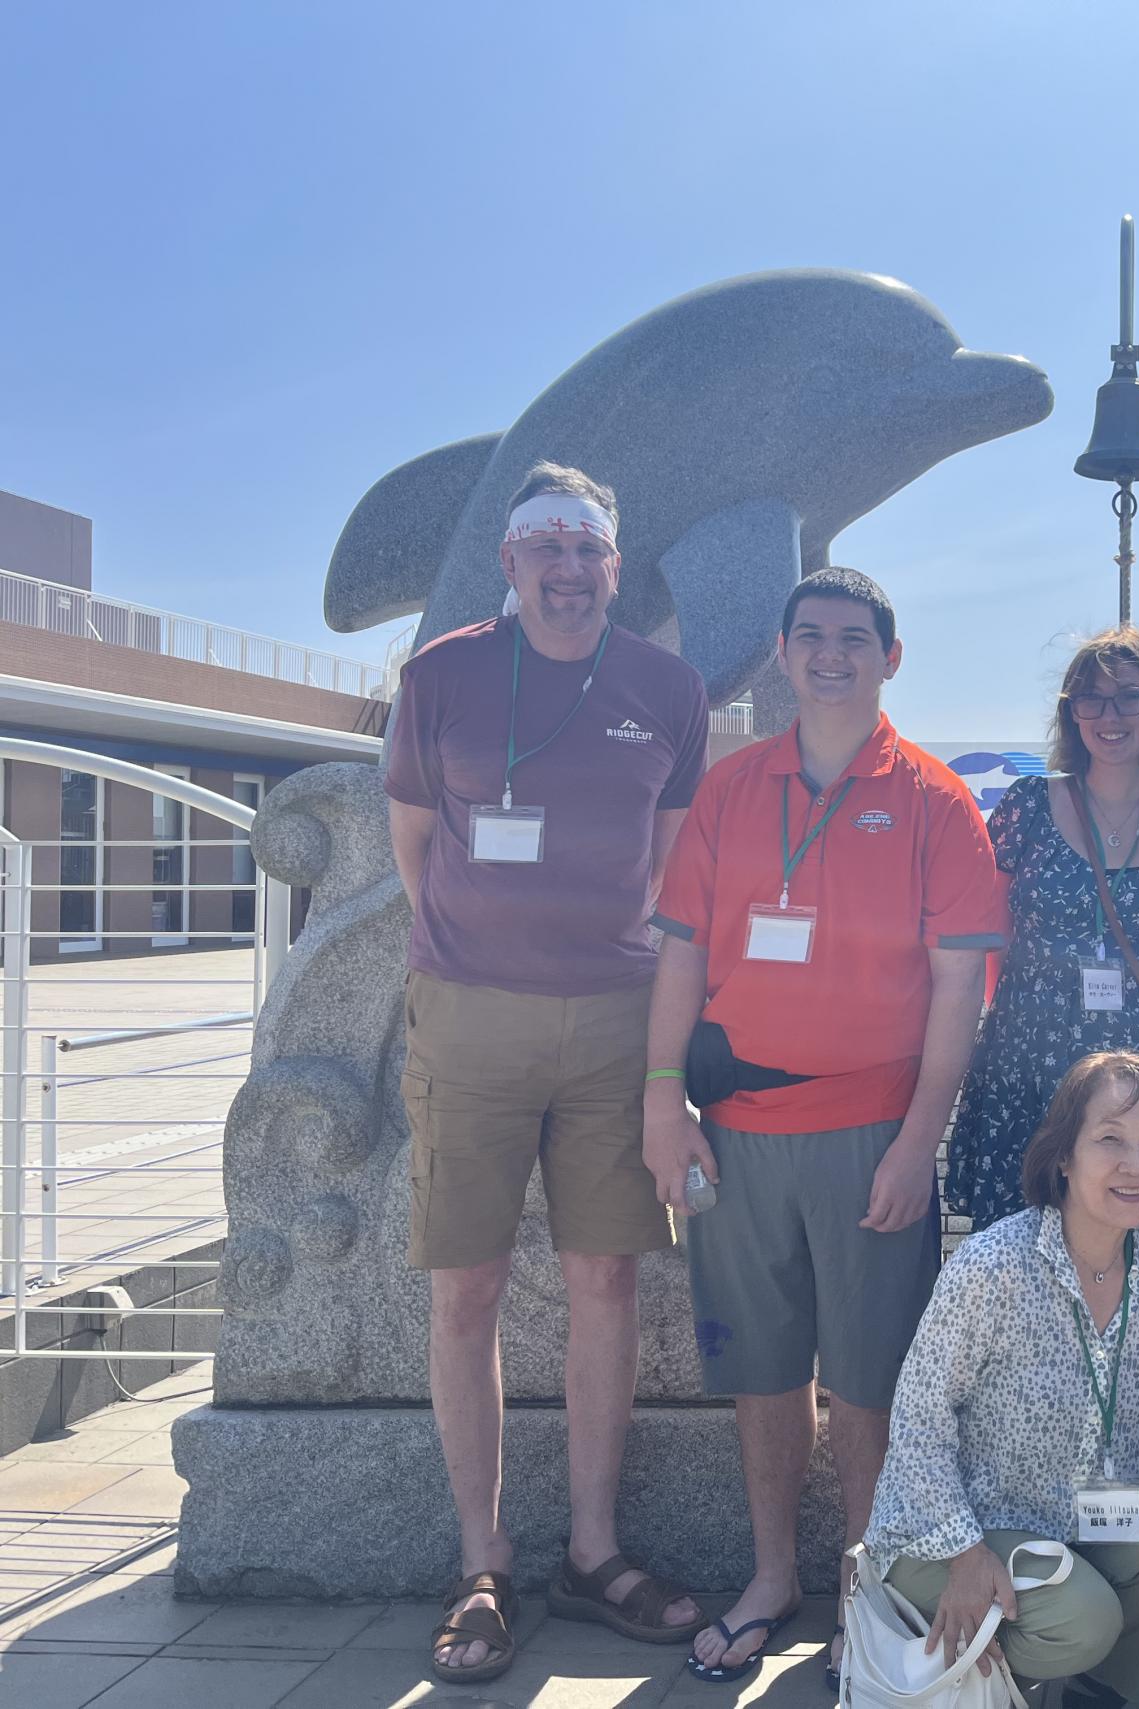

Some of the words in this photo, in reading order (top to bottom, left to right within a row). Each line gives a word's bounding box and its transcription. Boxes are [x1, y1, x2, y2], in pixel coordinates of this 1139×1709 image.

[606, 728, 653, 740] RIDGECUT
[1083, 1505, 1104, 1514] Youko
[1116, 1517, 1133, 1527] 洋子
